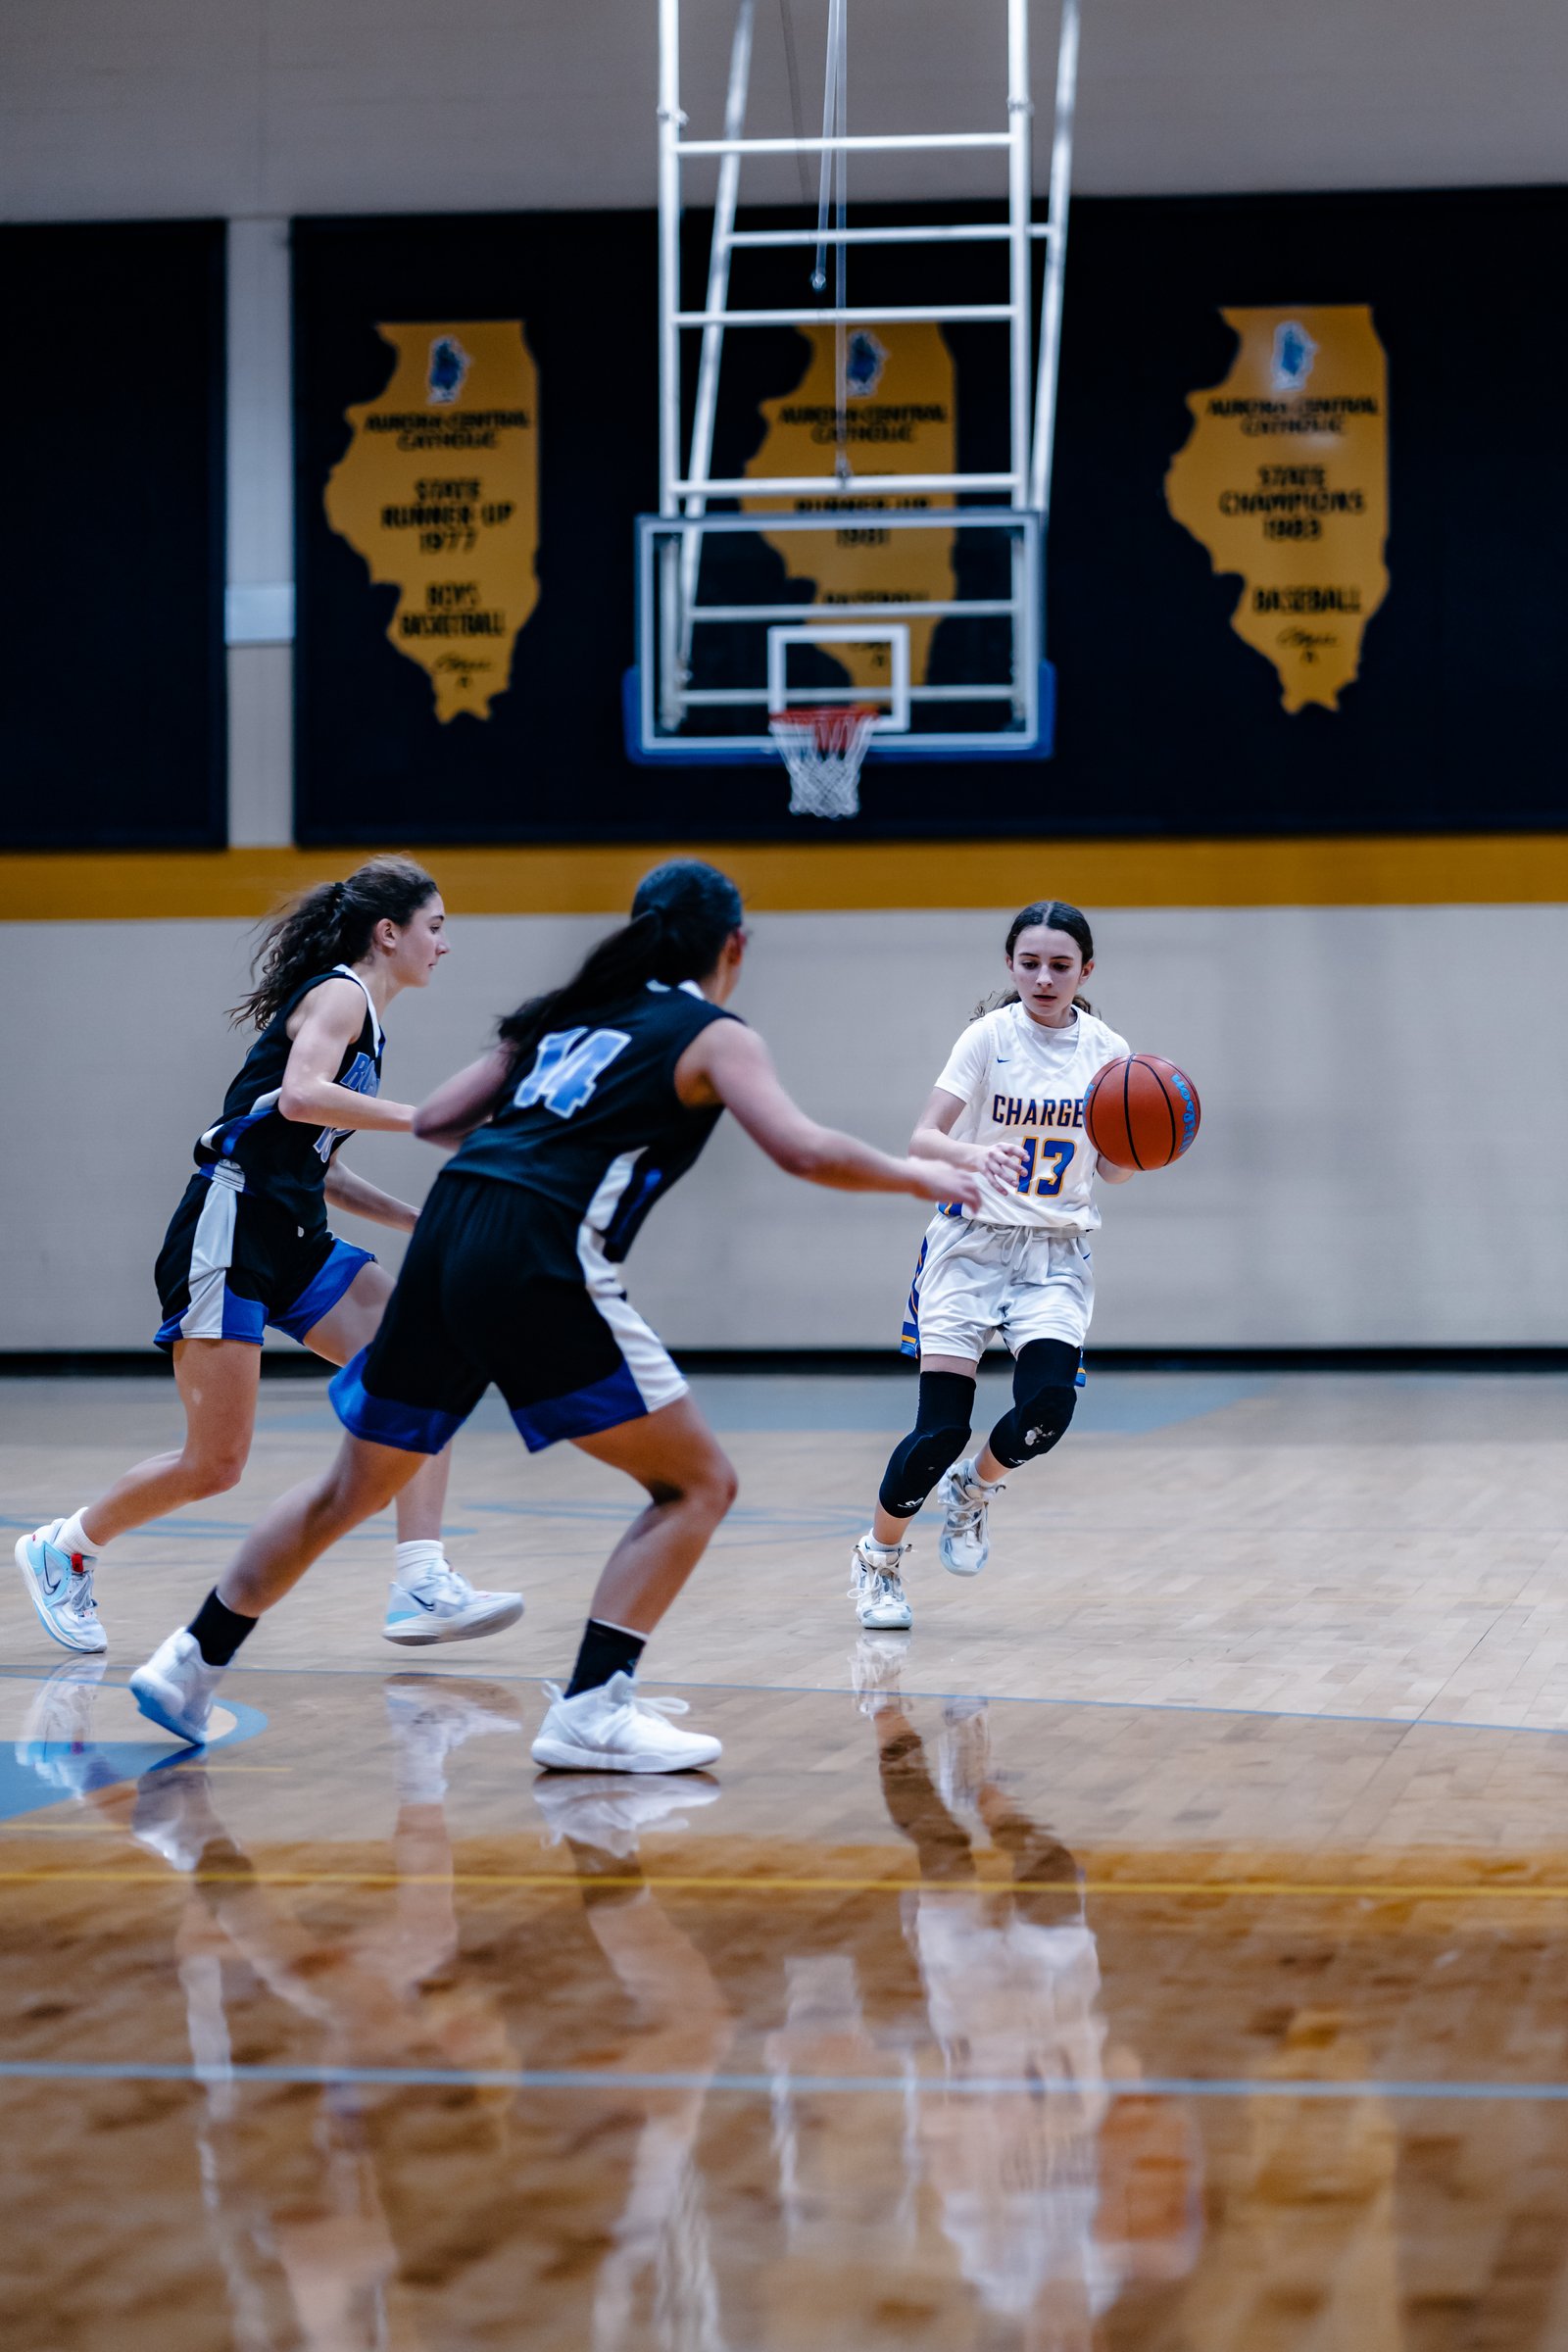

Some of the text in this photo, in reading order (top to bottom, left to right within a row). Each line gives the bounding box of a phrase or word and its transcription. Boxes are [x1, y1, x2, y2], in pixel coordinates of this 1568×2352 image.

[1260, 466, 1324, 485] STATE
[417, 479, 479, 499] STATE
[1220, 490, 1364, 514] CHAMPIONS
[382, 503, 514, 527] RUNNER UP
[421, 531, 476, 553] 1977
[427, 583, 477, 606] BOYS
[1254, 586, 1360, 612] BASEBALL
[401, 612, 506, 636] BASKETBALL
[992, 1094, 1084, 1128] CHARGE
[1015, 1136, 1078, 1198] 13
